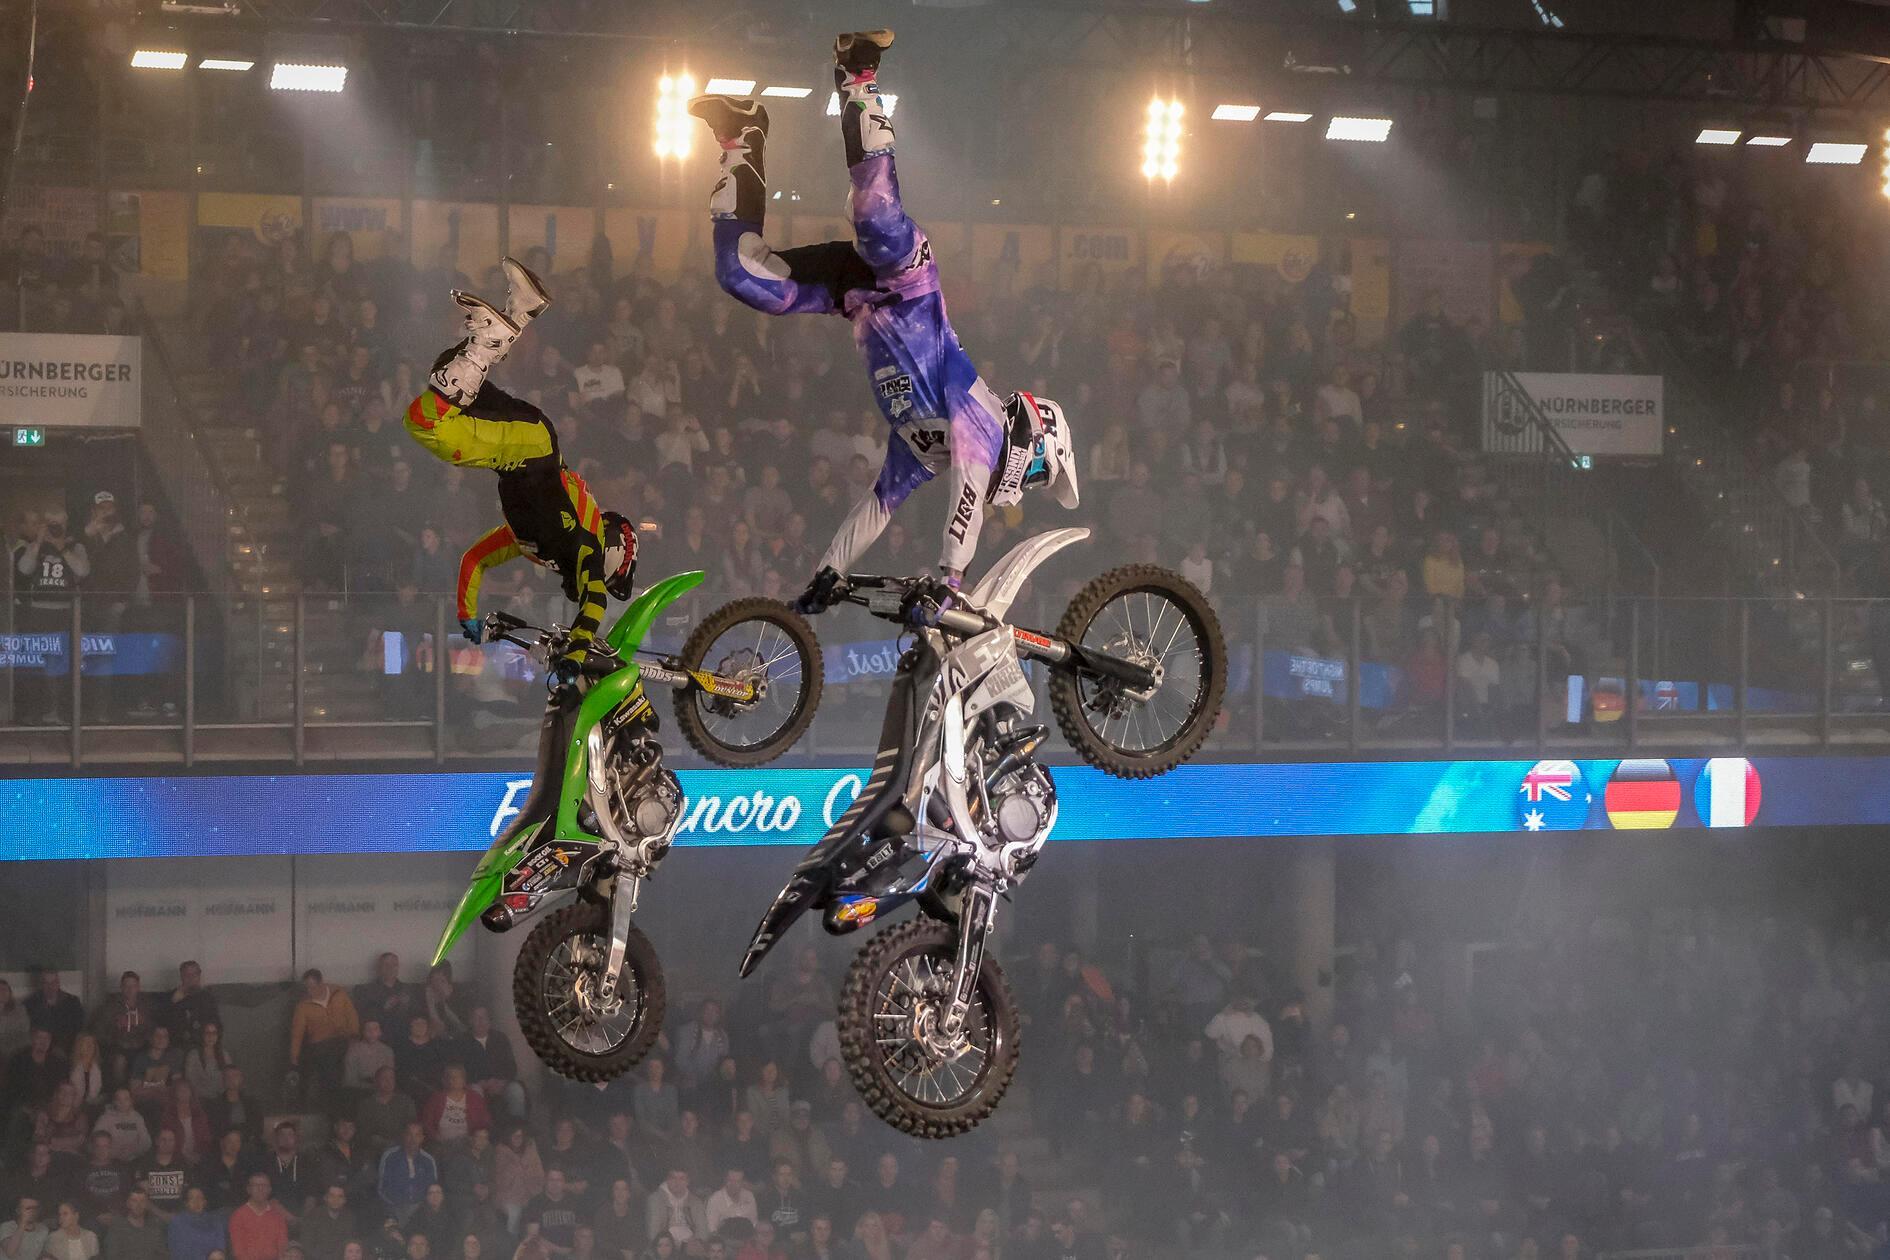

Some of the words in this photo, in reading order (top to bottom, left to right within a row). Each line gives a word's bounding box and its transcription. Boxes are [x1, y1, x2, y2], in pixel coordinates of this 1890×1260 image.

[1540, 396, 1656, 415] NÜRNBERGER
[42, 562, 64, 578] 18
[713, 685, 750, 697] DUNLOP
[613, 695, 646, 727] Kawasaki
